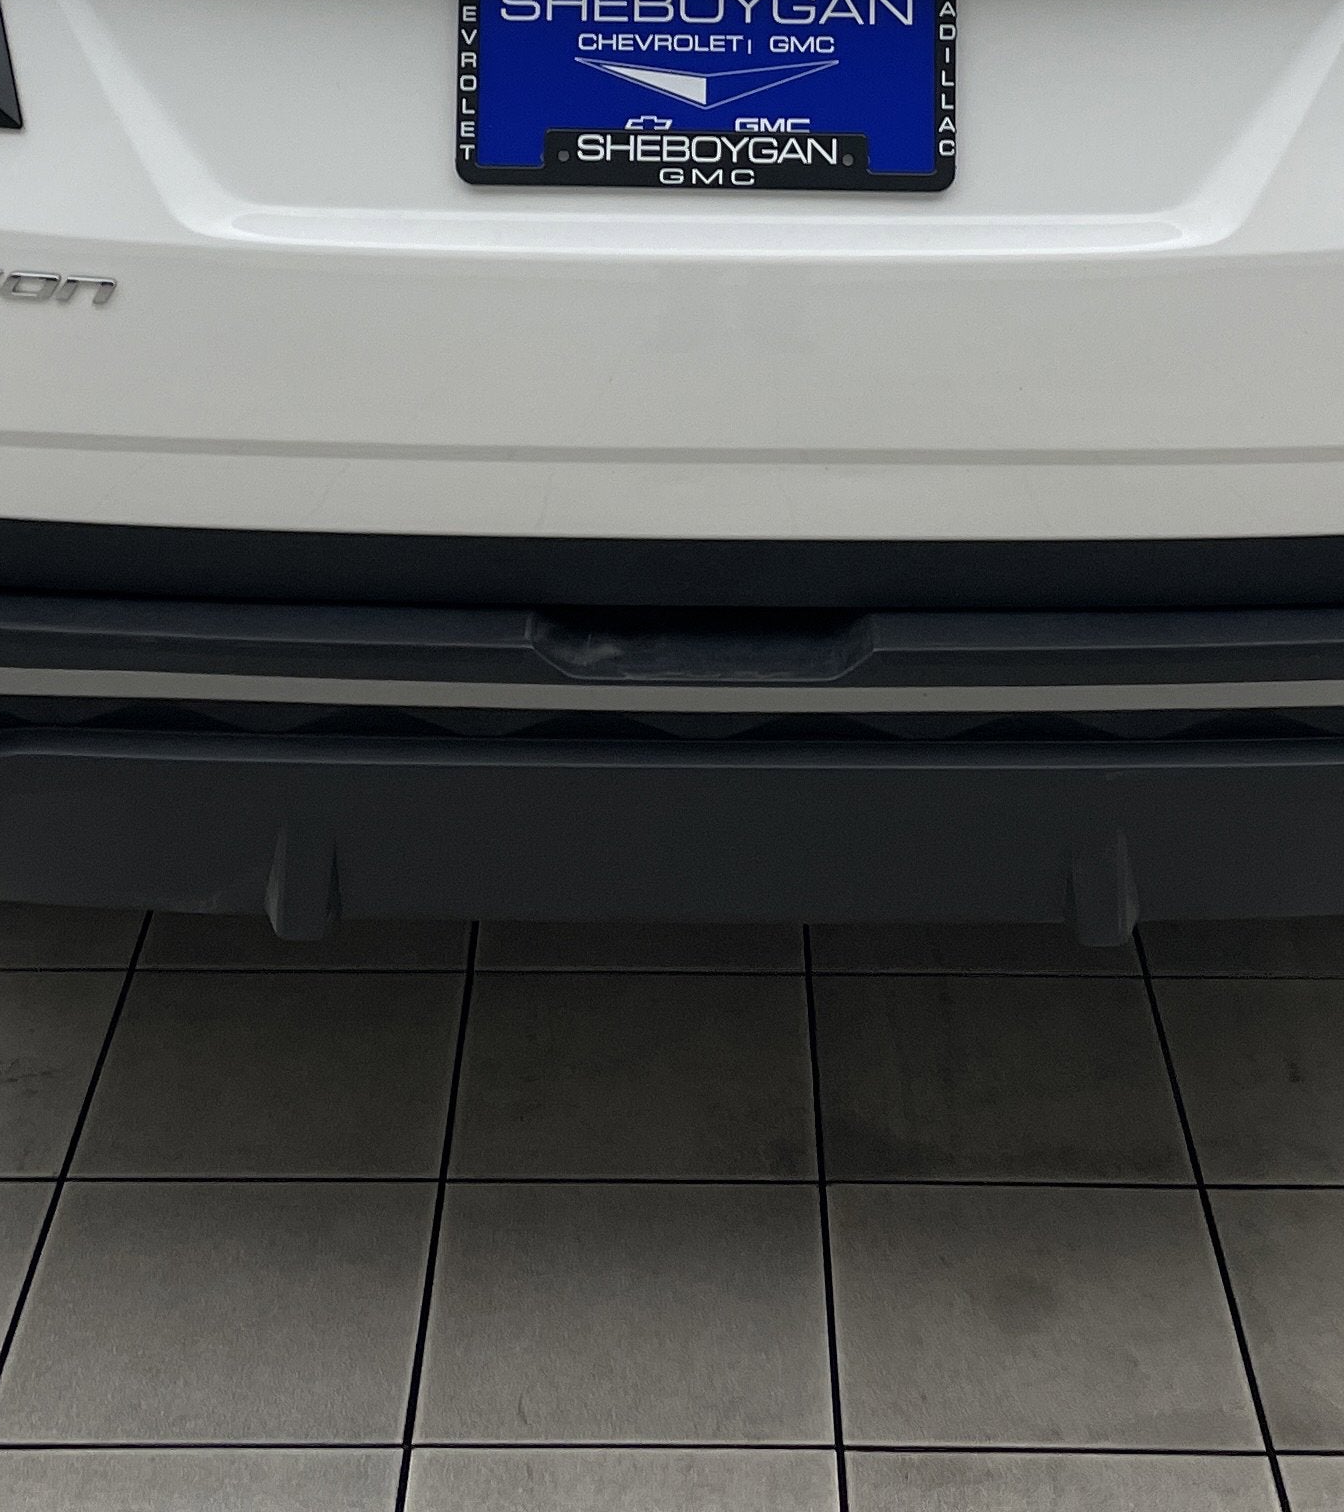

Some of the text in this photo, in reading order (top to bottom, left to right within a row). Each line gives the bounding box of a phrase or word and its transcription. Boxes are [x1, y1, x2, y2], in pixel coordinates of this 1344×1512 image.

[578, 33, 835, 54] CHEVROLET GMC
[734, 117, 811, 133] GMC
[576, 134, 838, 165] SHEBOYGAN
[659, 167, 756, 186] GMC
